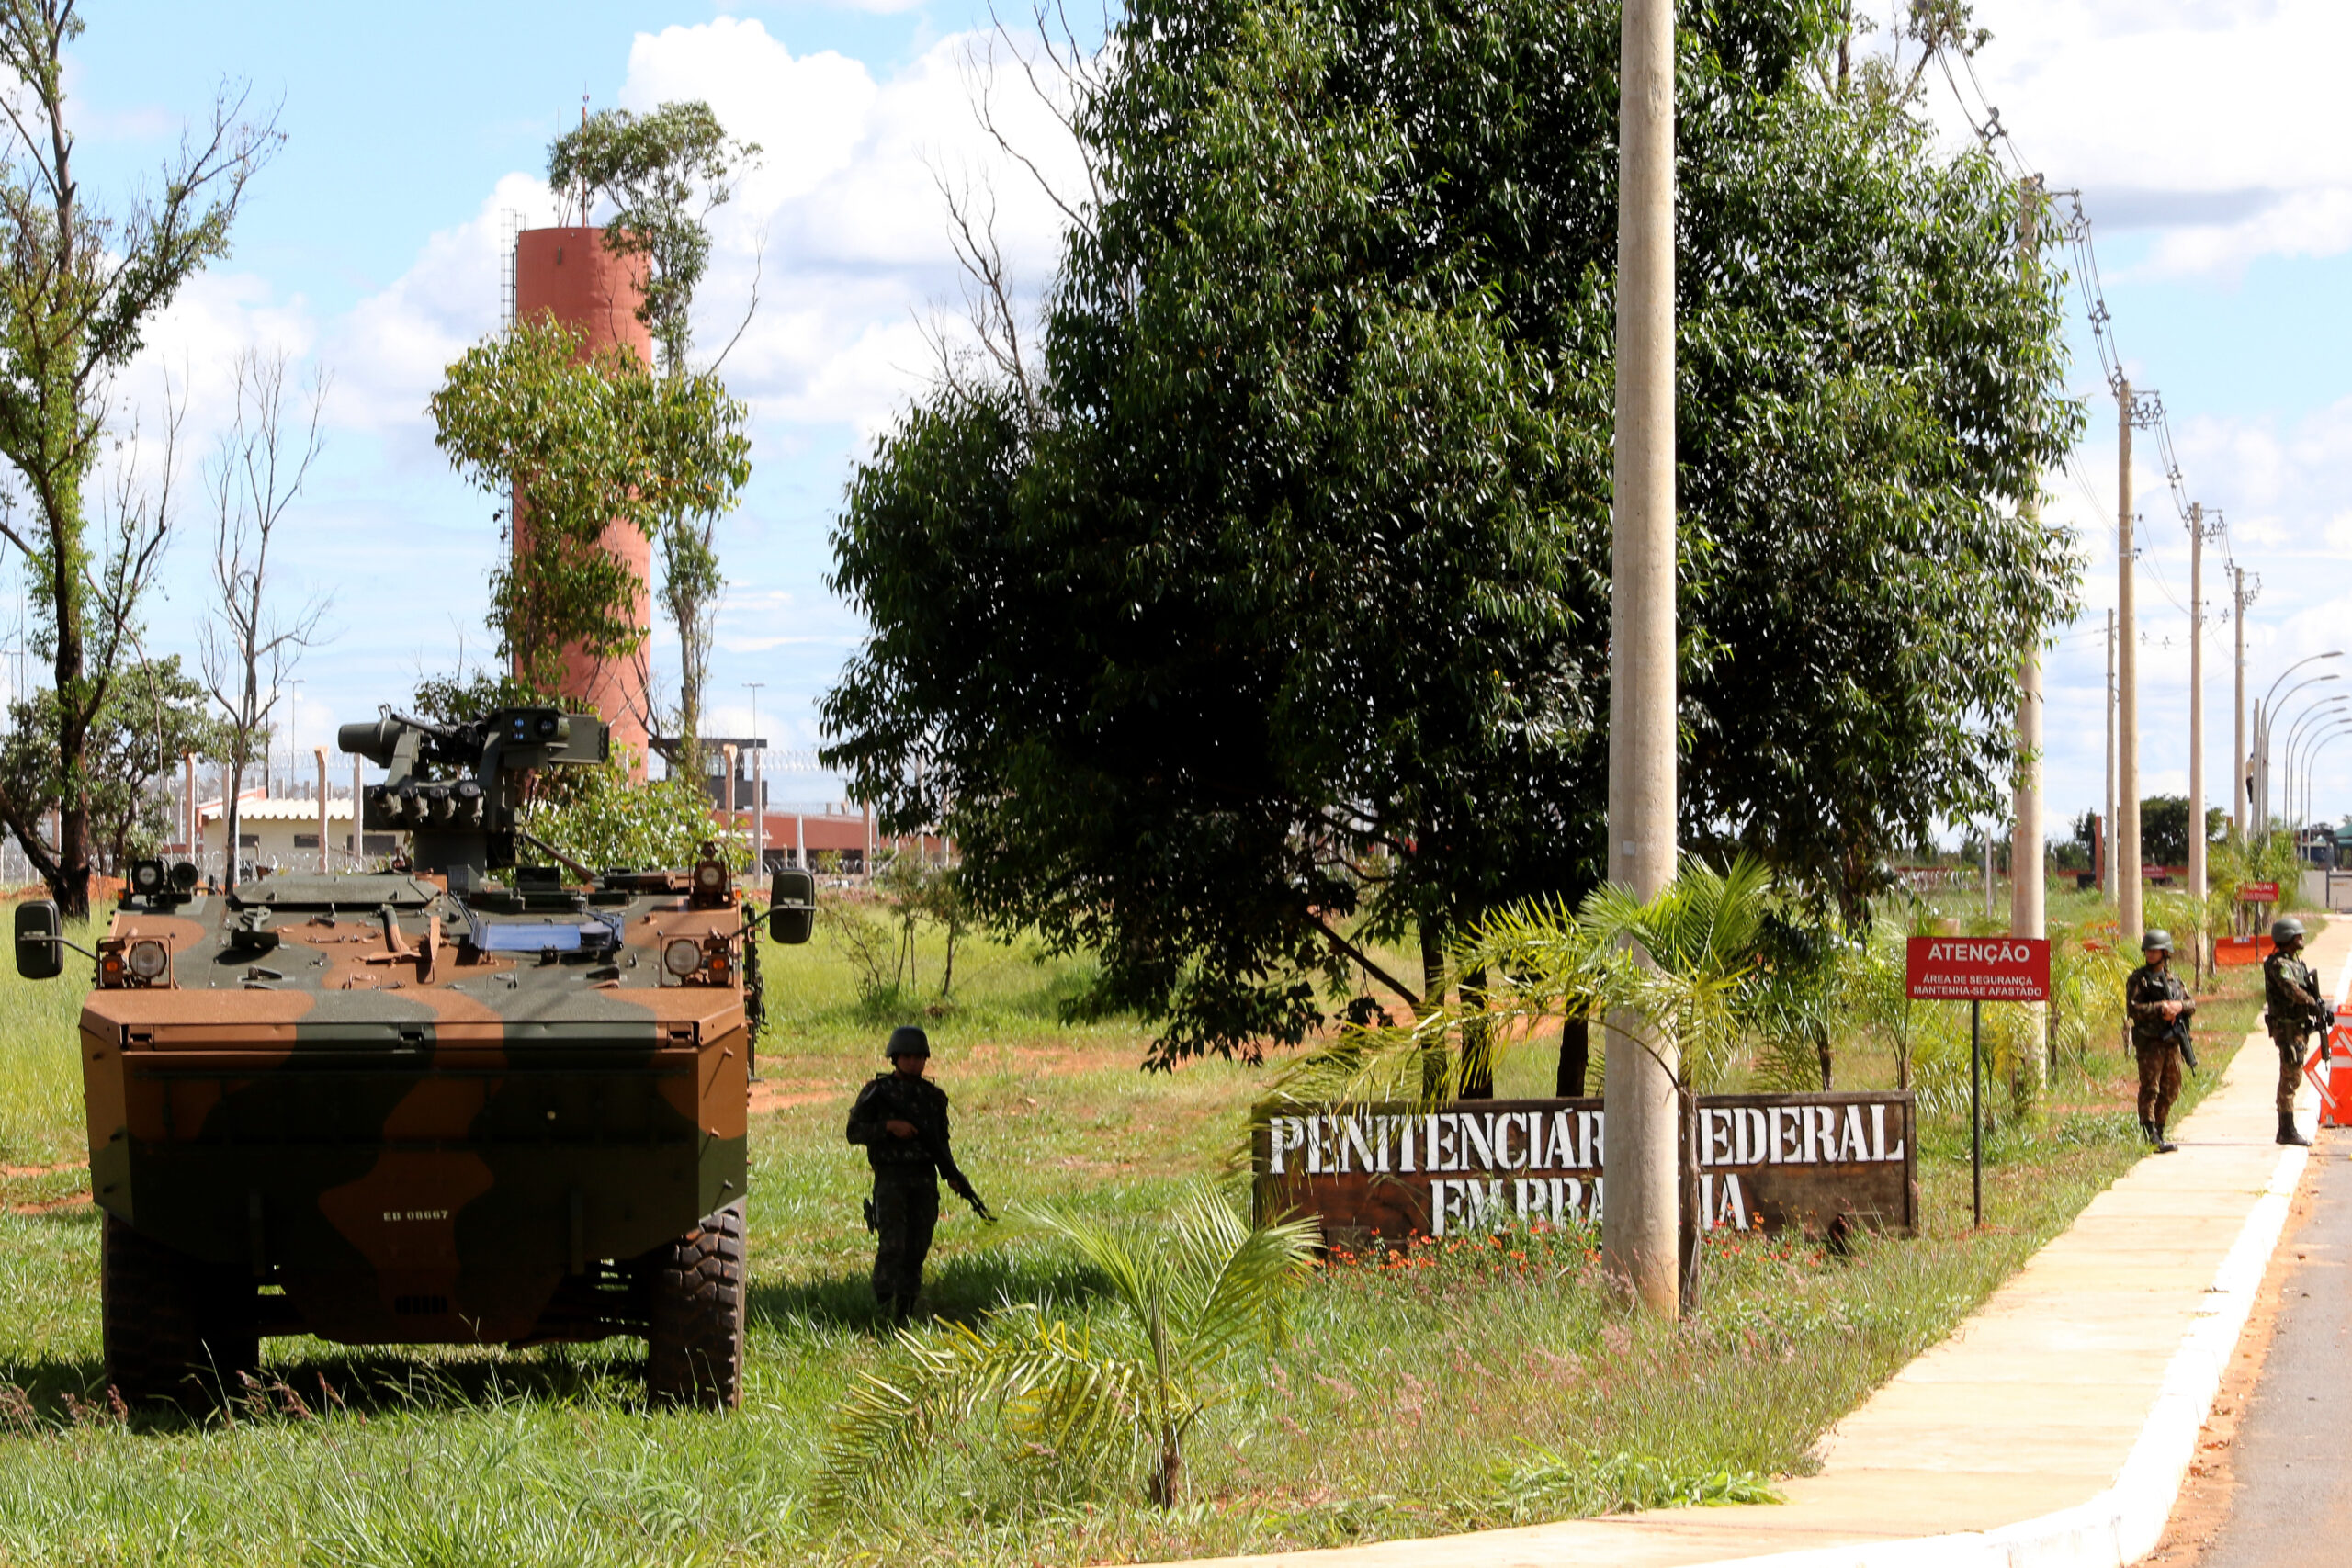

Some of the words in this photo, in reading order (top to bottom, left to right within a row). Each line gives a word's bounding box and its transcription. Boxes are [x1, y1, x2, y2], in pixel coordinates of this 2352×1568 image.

[1928, 941, 2030, 965] ATENÇÃO
[1922, 973, 1951, 984] ÁREA
[1953, 975, 1967, 985] DE
[1969, 976, 2033, 987] SEGURANÇA
[1913, 985, 1986, 996] MANTENHA-SE
[1988, 987, 2042, 997] AFASTADO
[1269, 1107, 1605, 1174] PENITENCIÁR
[1679, 1104, 1905, 1166] EDERAL
